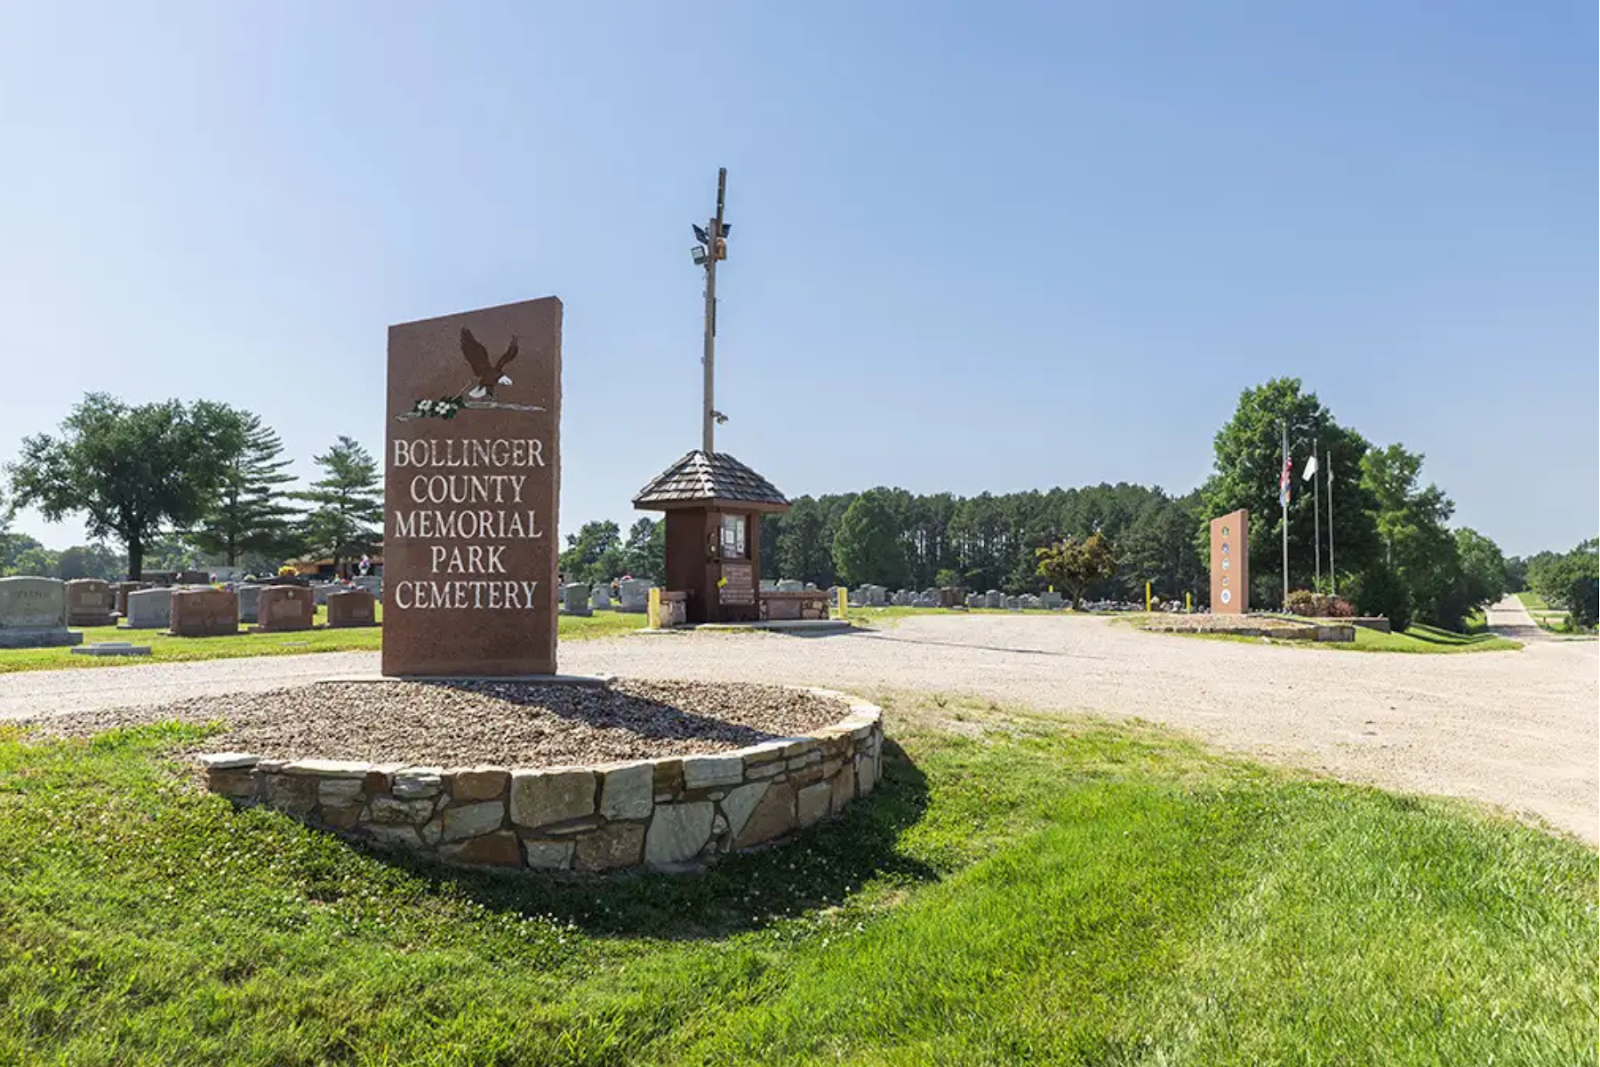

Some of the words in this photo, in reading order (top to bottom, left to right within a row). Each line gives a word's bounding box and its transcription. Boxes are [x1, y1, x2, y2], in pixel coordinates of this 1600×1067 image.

[393, 439, 545, 467] BOLLINGER
[410, 475, 526, 503] COUNTY
[394, 510, 543, 538] MEMORIAL
[431, 545, 507, 573] PARK
[395, 580, 538, 609] CEMETERY
